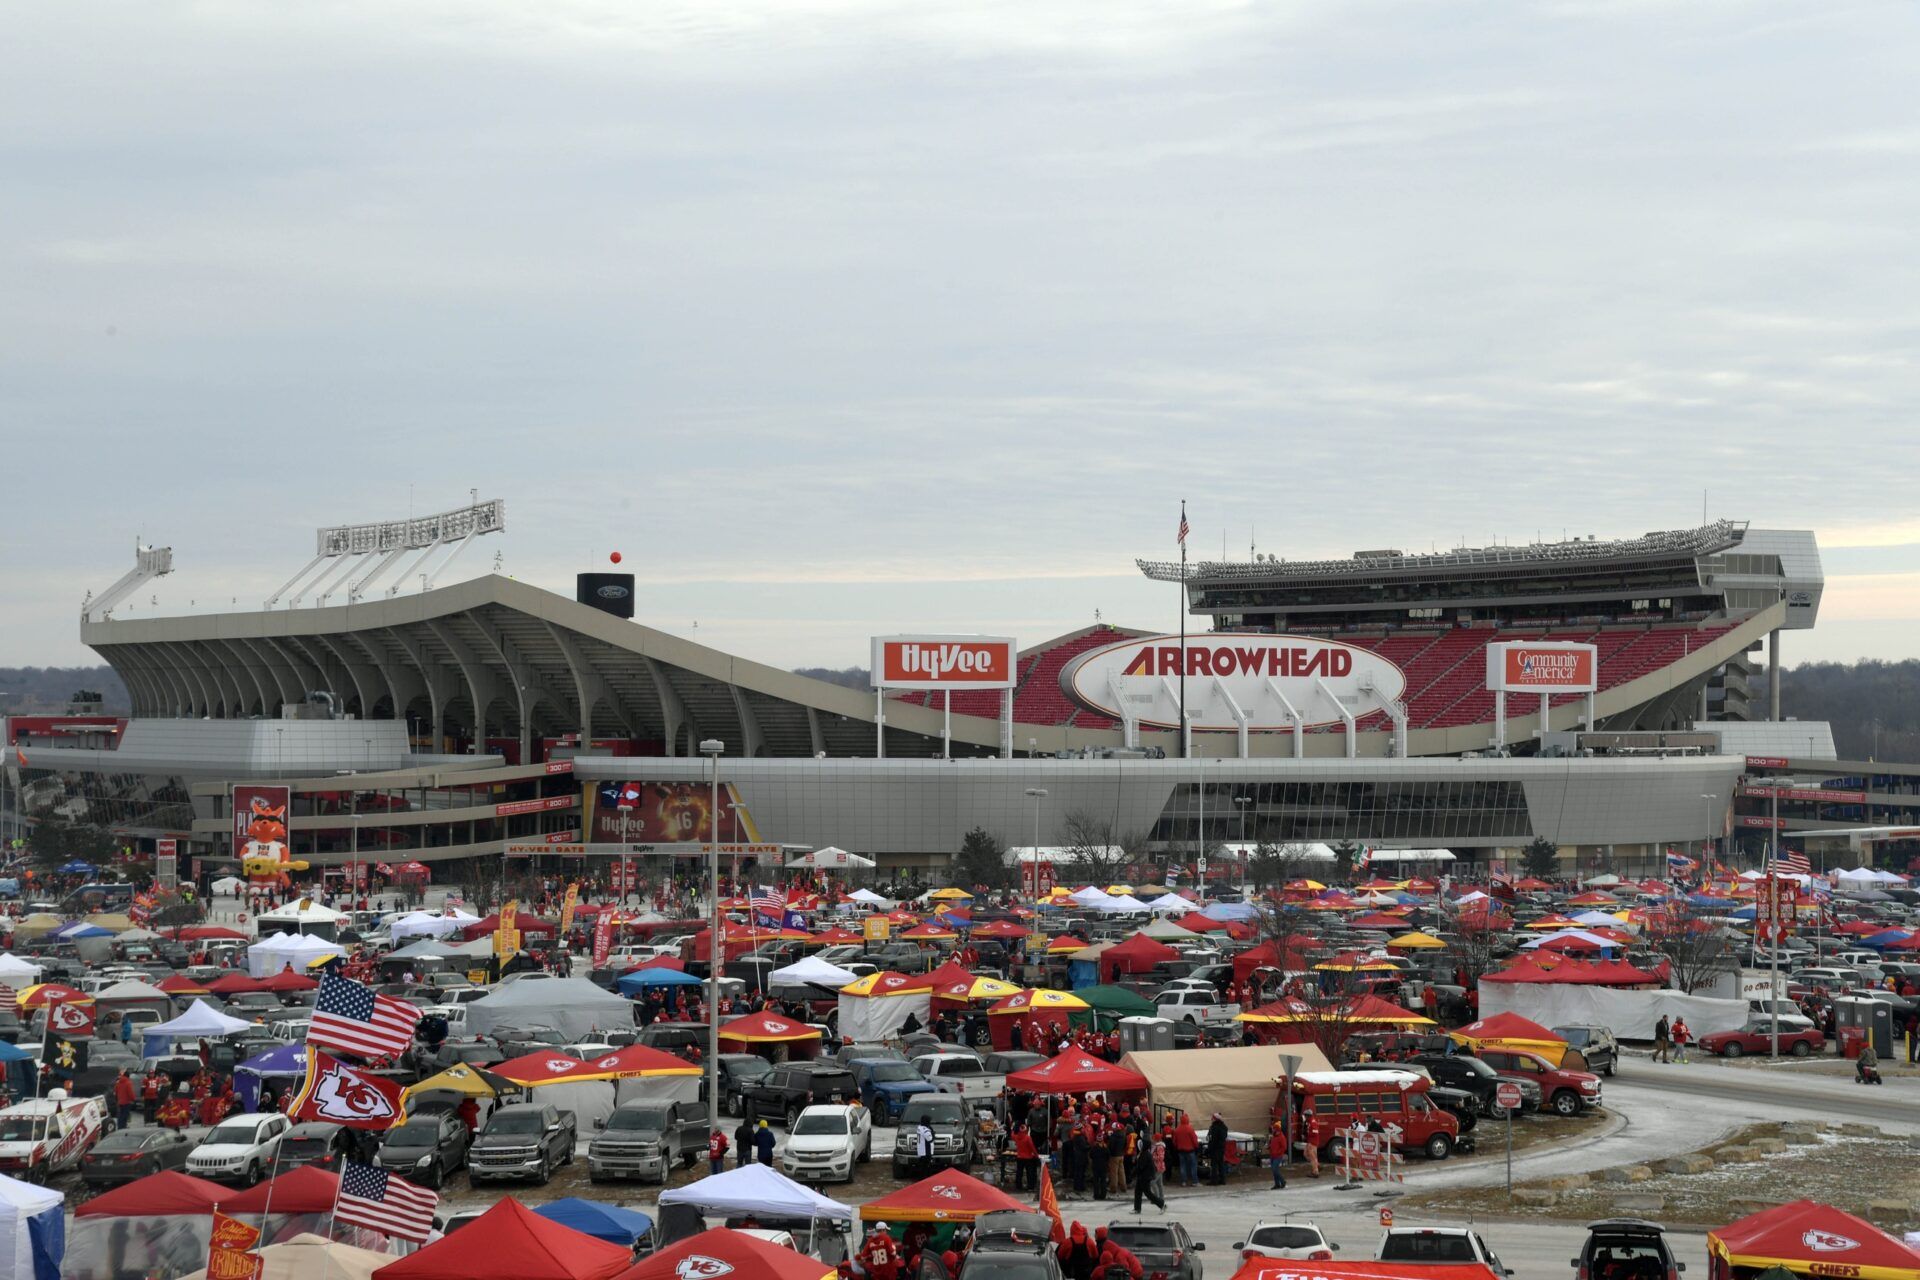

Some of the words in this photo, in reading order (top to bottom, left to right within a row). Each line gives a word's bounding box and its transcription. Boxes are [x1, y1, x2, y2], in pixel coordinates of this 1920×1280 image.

[1121, 647, 1353, 677] ARROWHEAD
[1517, 650, 1580, 668] Community
[674, 811, 693, 830] 16
[595, 925, 604, 960] PARKING
[1743, 984, 1754, 992] GO
[619, 1070, 642, 1078] CHIEFS
[1808, 1262, 1861, 1277] CHIEFS
